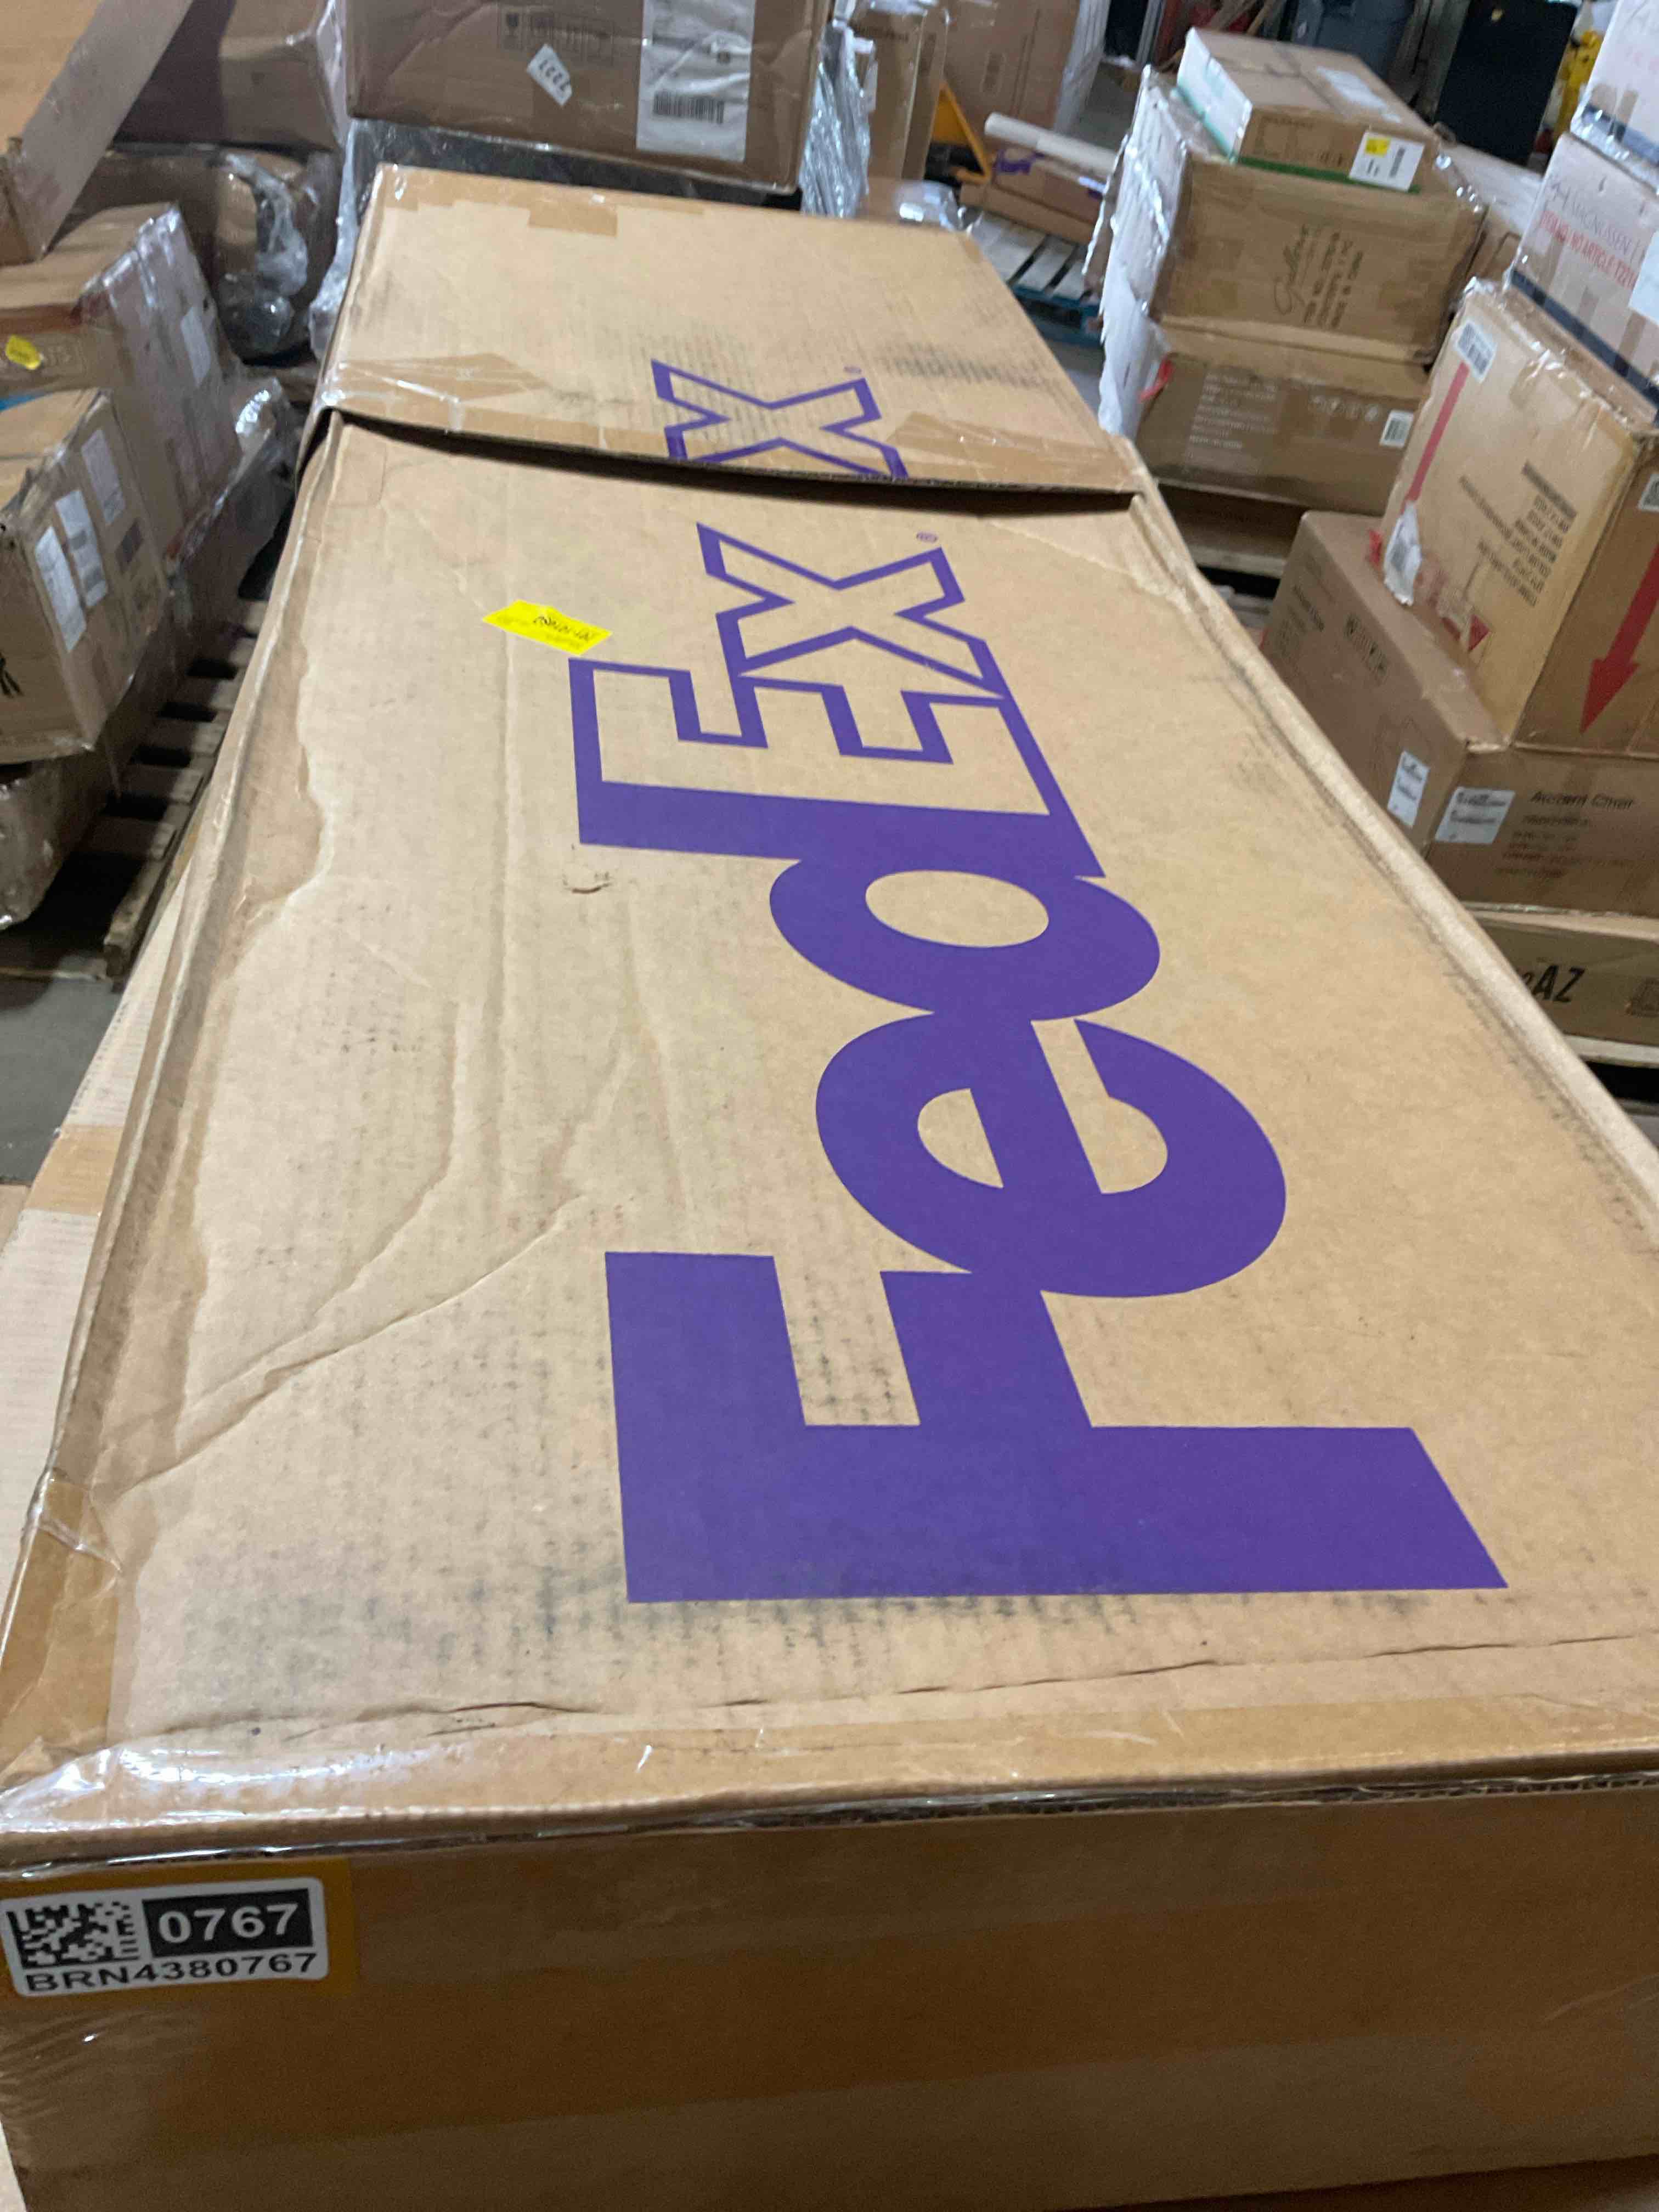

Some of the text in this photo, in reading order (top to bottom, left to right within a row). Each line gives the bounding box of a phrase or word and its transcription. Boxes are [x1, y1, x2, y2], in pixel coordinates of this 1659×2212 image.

[569, 523, 1508, 1604] FedEx
[159, 1903, 298, 1943] 0767
[26, 1952, 318, 1993] BRN4380767
